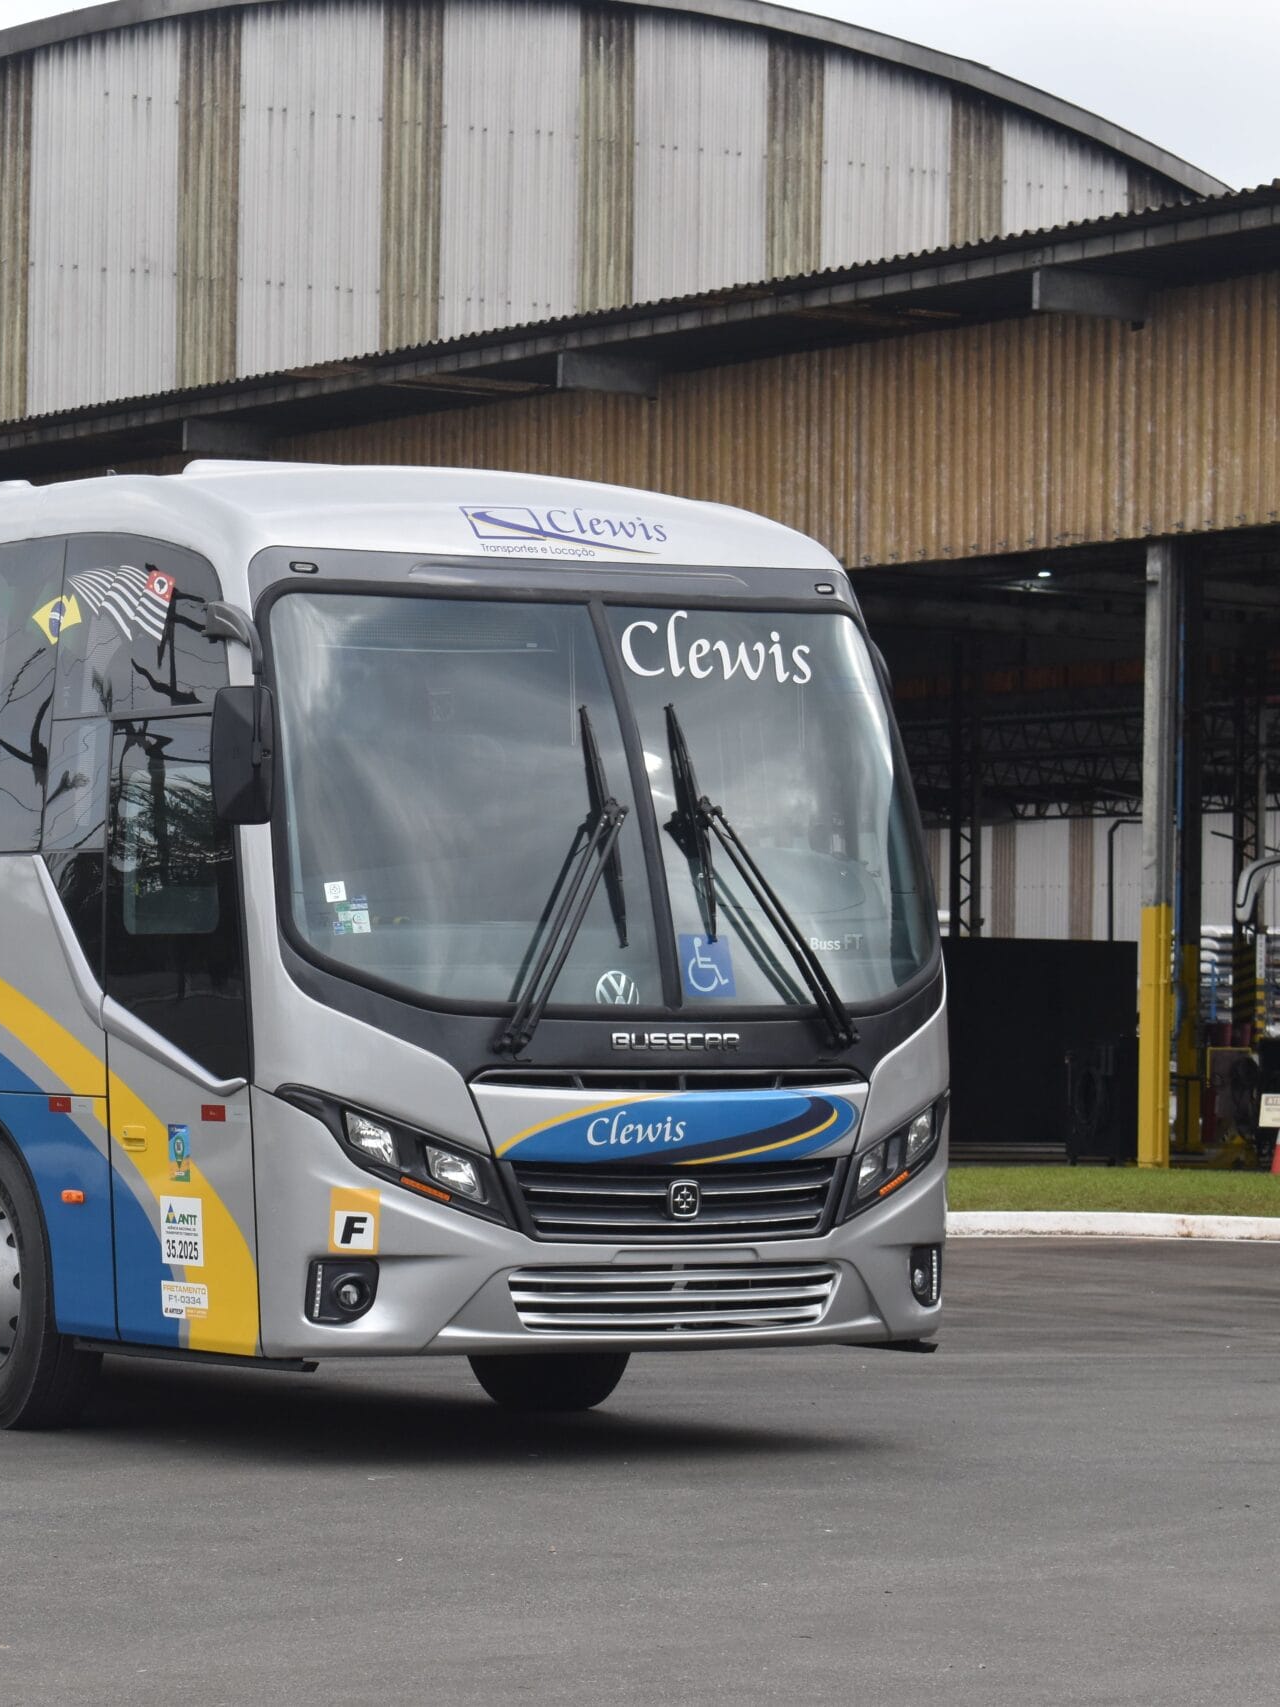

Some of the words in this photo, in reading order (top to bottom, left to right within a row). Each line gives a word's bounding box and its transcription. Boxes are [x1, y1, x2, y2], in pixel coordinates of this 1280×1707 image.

[546, 508, 668, 542] Clewis
[480, 543, 539, 554] Transportes
[549, 545, 596, 558] Locação
[621, 610, 812, 684] Clewis
[809, 937, 841, 951] Buss
[843, 933, 863, 951] FT
[611, 1032, 741, 1051] BUSSCAR
[586, 1110, 687, 1146] Clewis
[177, 1213, 198, 1226] ANTT
[340, 1215, 368, 1245] F
[166, 1238, 199, 1261] 35.2025
[163, 1284, 207, 1295] FRETAMENTO
[168, 1294, 202, 1306] F1-0334
